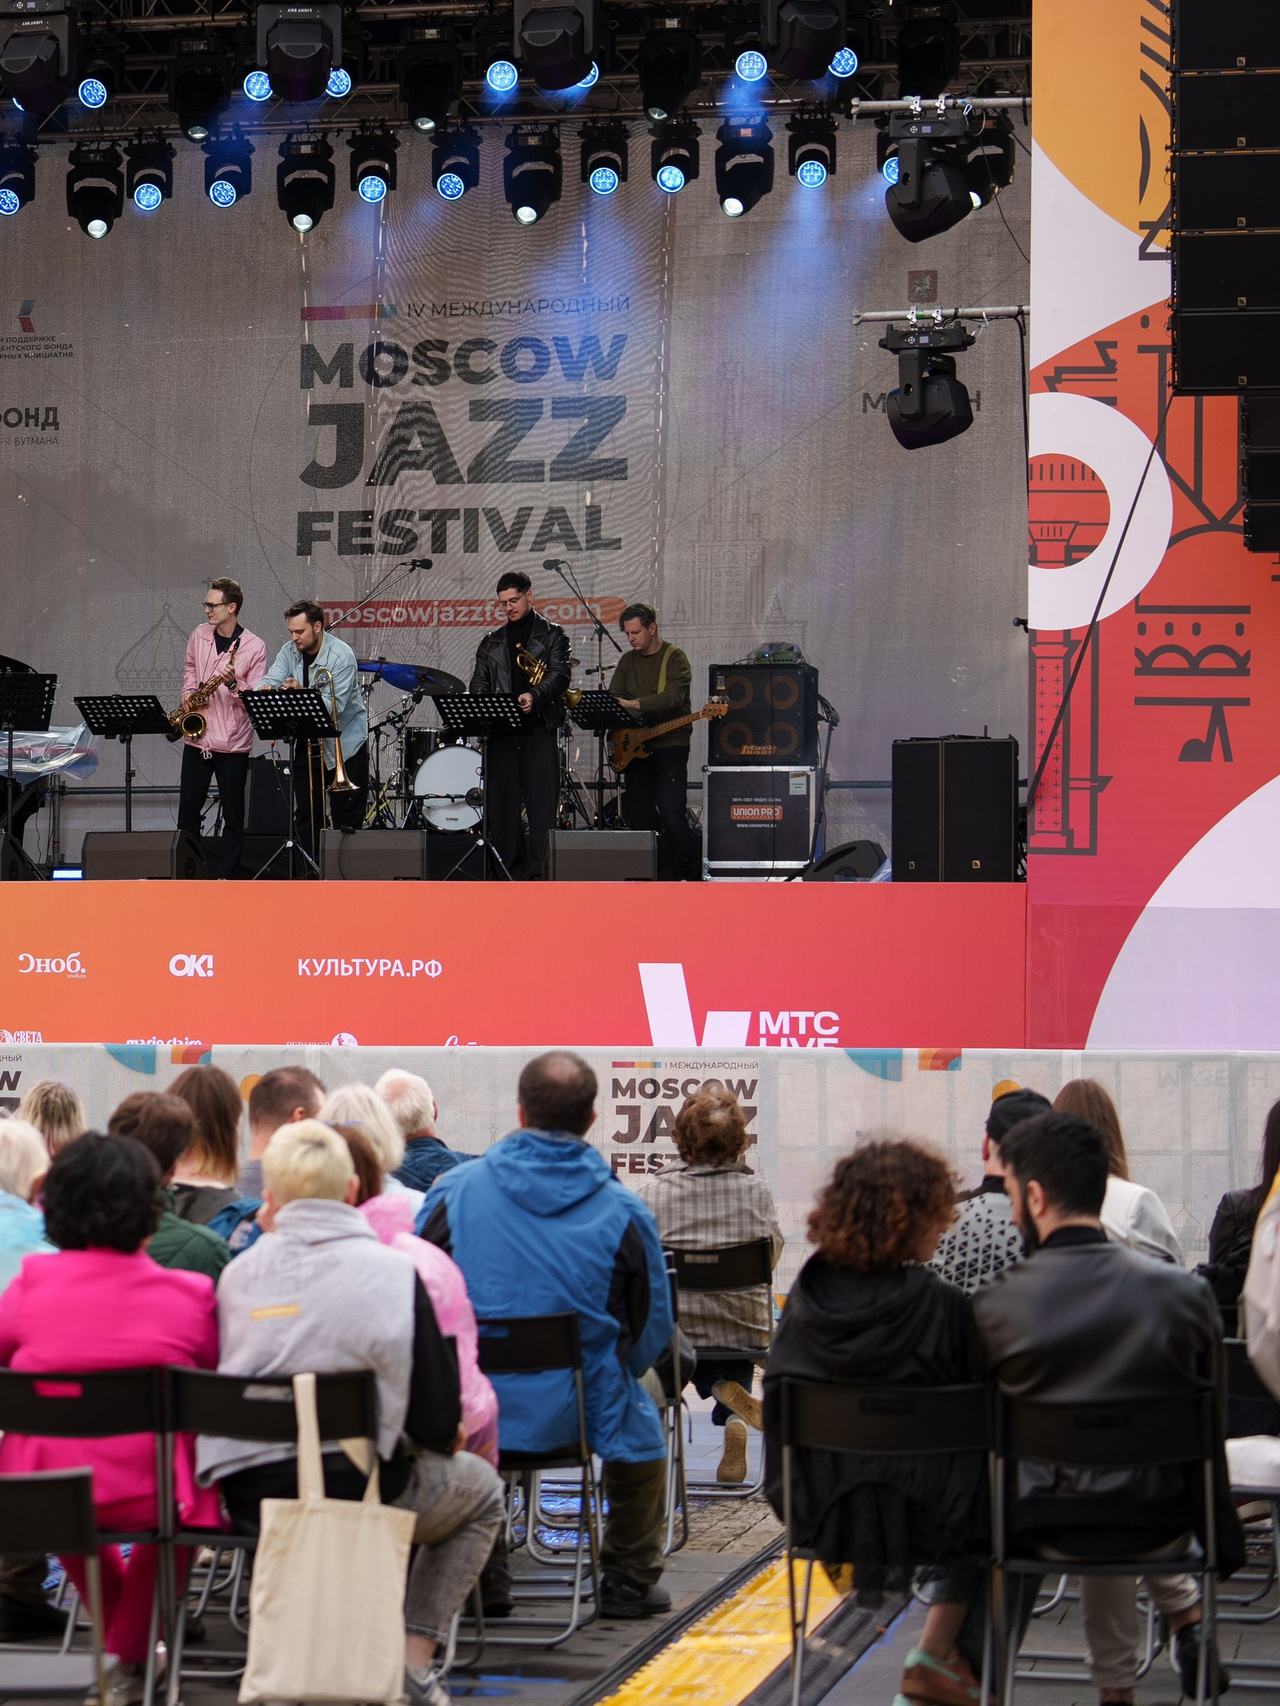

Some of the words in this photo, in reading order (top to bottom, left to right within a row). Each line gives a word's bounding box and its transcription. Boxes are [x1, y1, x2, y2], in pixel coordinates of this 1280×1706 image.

[431, 294, 630, 318] МЕЖДУНАРОДНЫЙ
[6, 335, 56, 344] ПОДДЕРЖКЕ
[43, 343, 74, 351] ФОНДА
[24, 351, 74, 360] ИНИЦИАТИВ
[299, 334, 628, 390] MOSCOW
[14, 436, 59, 446] БУТМАНА
[298, 395, 628, 490] JAZZ
[296, 505, 622, 556] FESTIVAL
[733, 807, 760, 816] UNION
[760, 807, 780, 816] PRO
[168, 953, 214, 978] OK!
[297, 957, 443, 978] КУЛЬТУРА.РФ
[670, 1061, 759, 1070] МЕЖДУНАРОДНЫЙ
